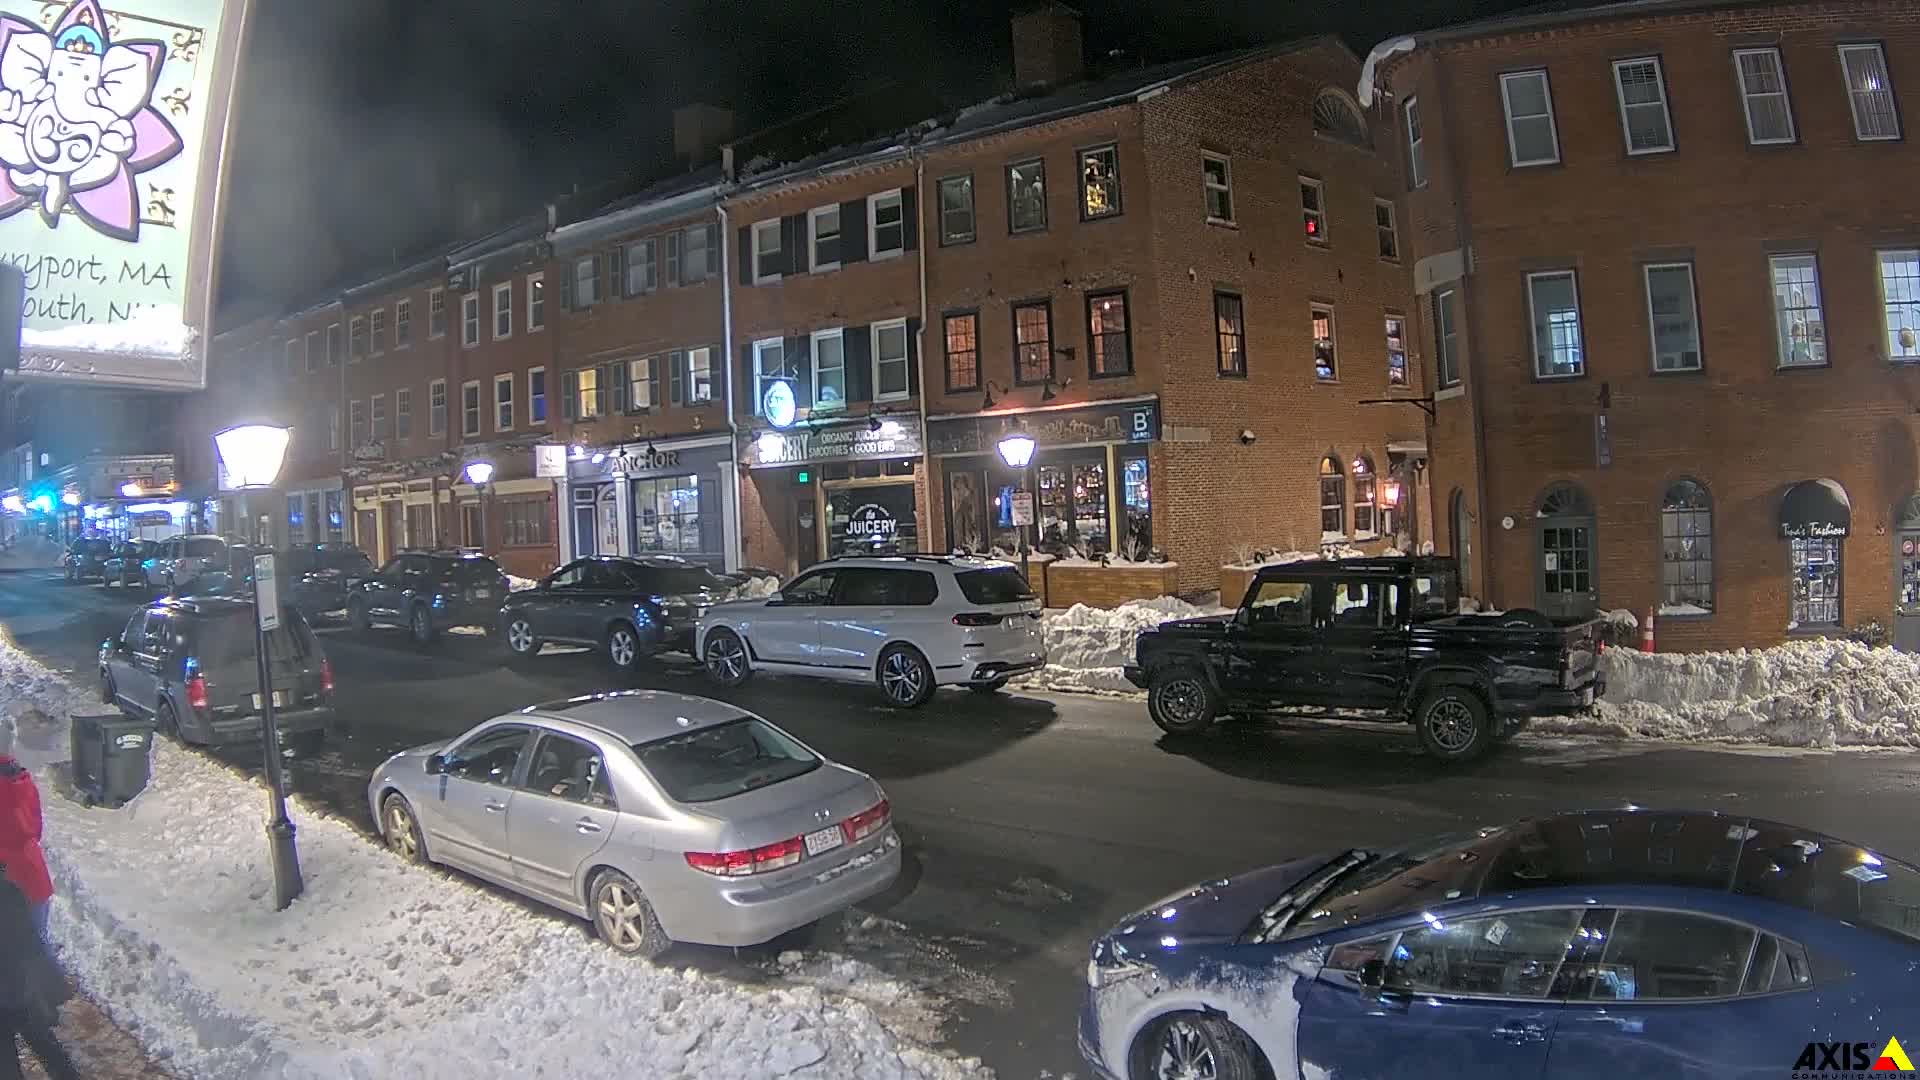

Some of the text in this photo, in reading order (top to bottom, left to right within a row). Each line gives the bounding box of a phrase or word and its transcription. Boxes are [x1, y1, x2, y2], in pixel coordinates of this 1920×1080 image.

[119, 259, 172, 289] MA
[23, 292, 156, 325] outh, N
[821, 431, 852, 443] ORGANIC
[855, 442, 876, 453] GOOD
[758, 433, 808, 463] ICERY
[611, 451, 680, 472] ANCHOR
[846, 519, 896, 534] JUICERY
